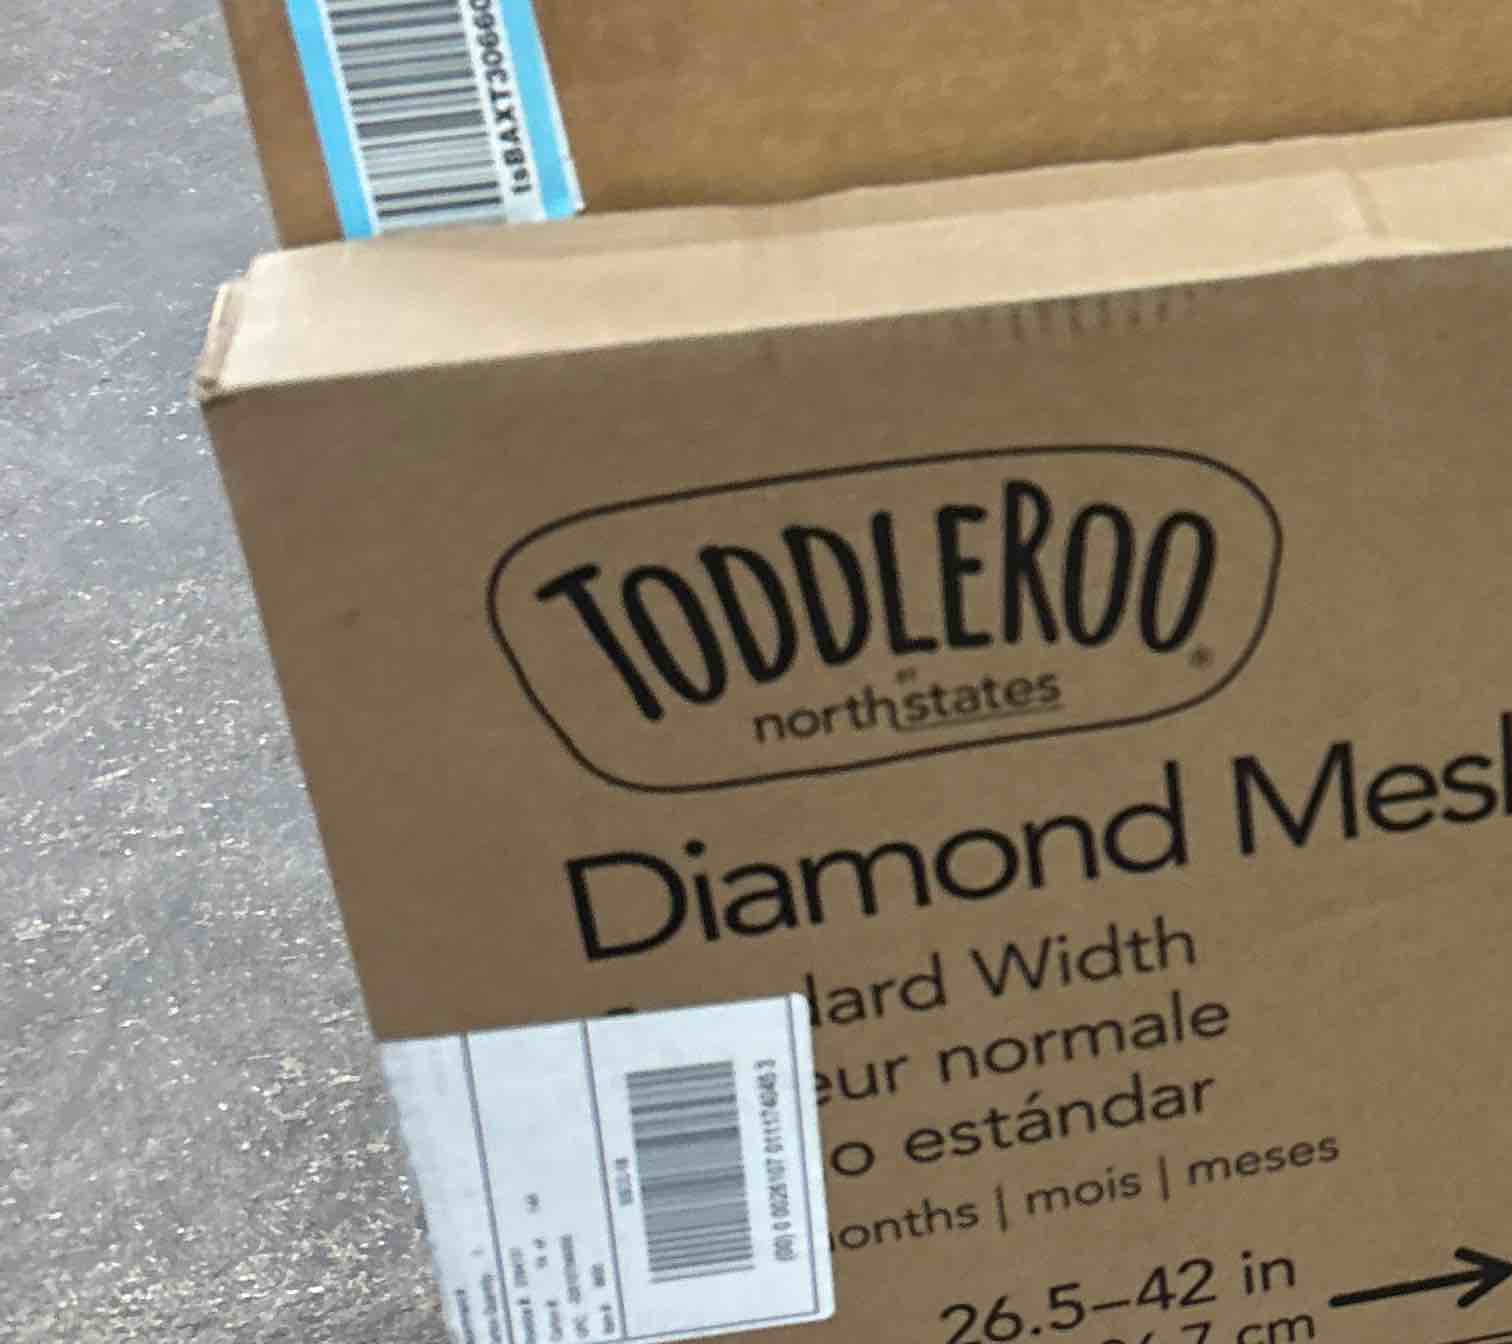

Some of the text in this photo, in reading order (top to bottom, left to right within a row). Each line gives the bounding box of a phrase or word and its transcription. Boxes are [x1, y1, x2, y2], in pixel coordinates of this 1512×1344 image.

[536, 478, 1217, 720] TODDLEROO
[752, 669, 1062, 744] northstates
[564, 760, 1190, 962] Diamond
[972, 915, 1198, 999] Width
[937, 993, 1231, 1085] normale
[904, 1070, 1217, 1159] estándar
[828, 1135, 1341, 1256] onths mois meses
[1241, 1251, 1297, 1296] in
